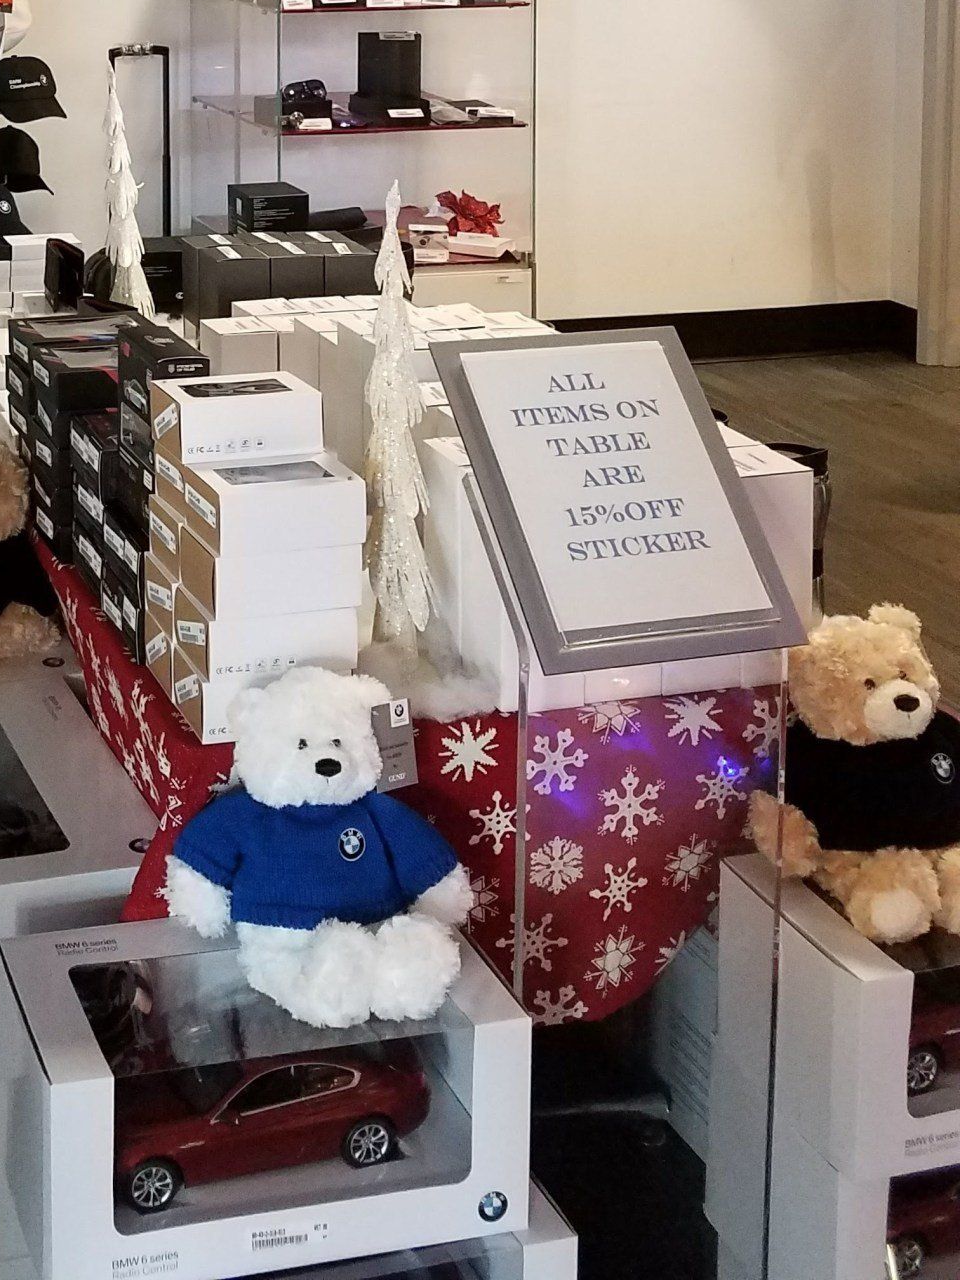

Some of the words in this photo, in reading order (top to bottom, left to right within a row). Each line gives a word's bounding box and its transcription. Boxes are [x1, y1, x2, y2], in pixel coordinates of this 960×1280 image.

[548, 373, 606, 393] ALL
[509, 402, 610, 427] ITEMS
[616, 399, 661, 420] ON
[546, 431, 651, 457] TABLE
[582, 464, 646, 488] ARE
[565, 498, 687, 527] 15%OFF
[567, 529, 711, 561] STICKER
[55, 941, 80, 950] BMW
[112, 1256, 139, 1269] BMW
[141, 1255, 148, 1264] 6
[150, 1251, 179, 1263] series
[142, 1260, 179, 1275] Control
